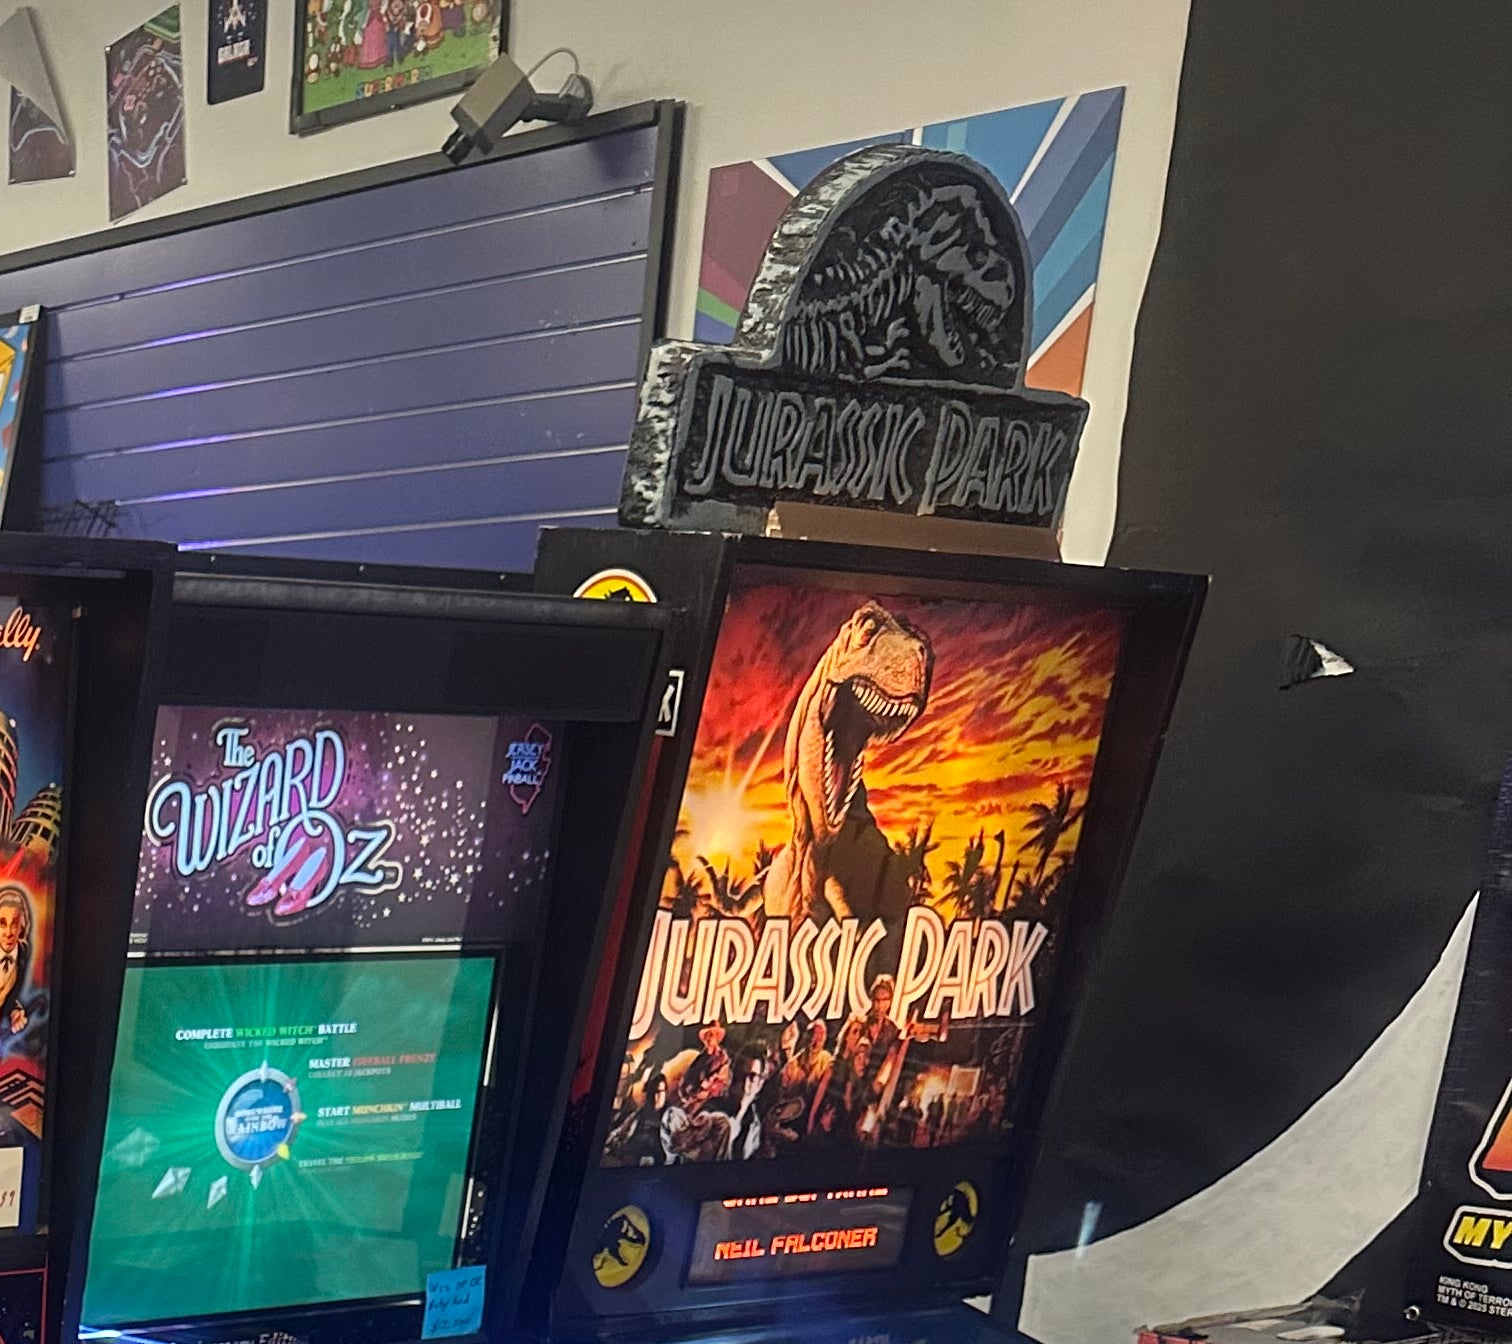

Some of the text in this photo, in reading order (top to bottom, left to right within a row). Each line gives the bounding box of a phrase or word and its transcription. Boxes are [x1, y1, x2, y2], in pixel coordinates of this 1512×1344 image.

[685, 373, 1070, 516] JURASSIC PARK
[216, 727, 255, 767] The
[510, 759, 538, 773] JACK
[152, 729, 346, 876] WIZARD
[252, 823, 282, 869] of
[629, 905, 1049, 1040] JURASSIC PARK
[175, 1027, 234, 1041] COMPLETE
[317, 1022, 358, 1035] BATTLE
[308, 1057, 351, 1069] MASTER
[317, 1099, 462, 1118] START MULTIBALL
[714, 1226, 879, 1261] NEIL FALCONER
[1438, 1285, 1462, 1298] MYTH
